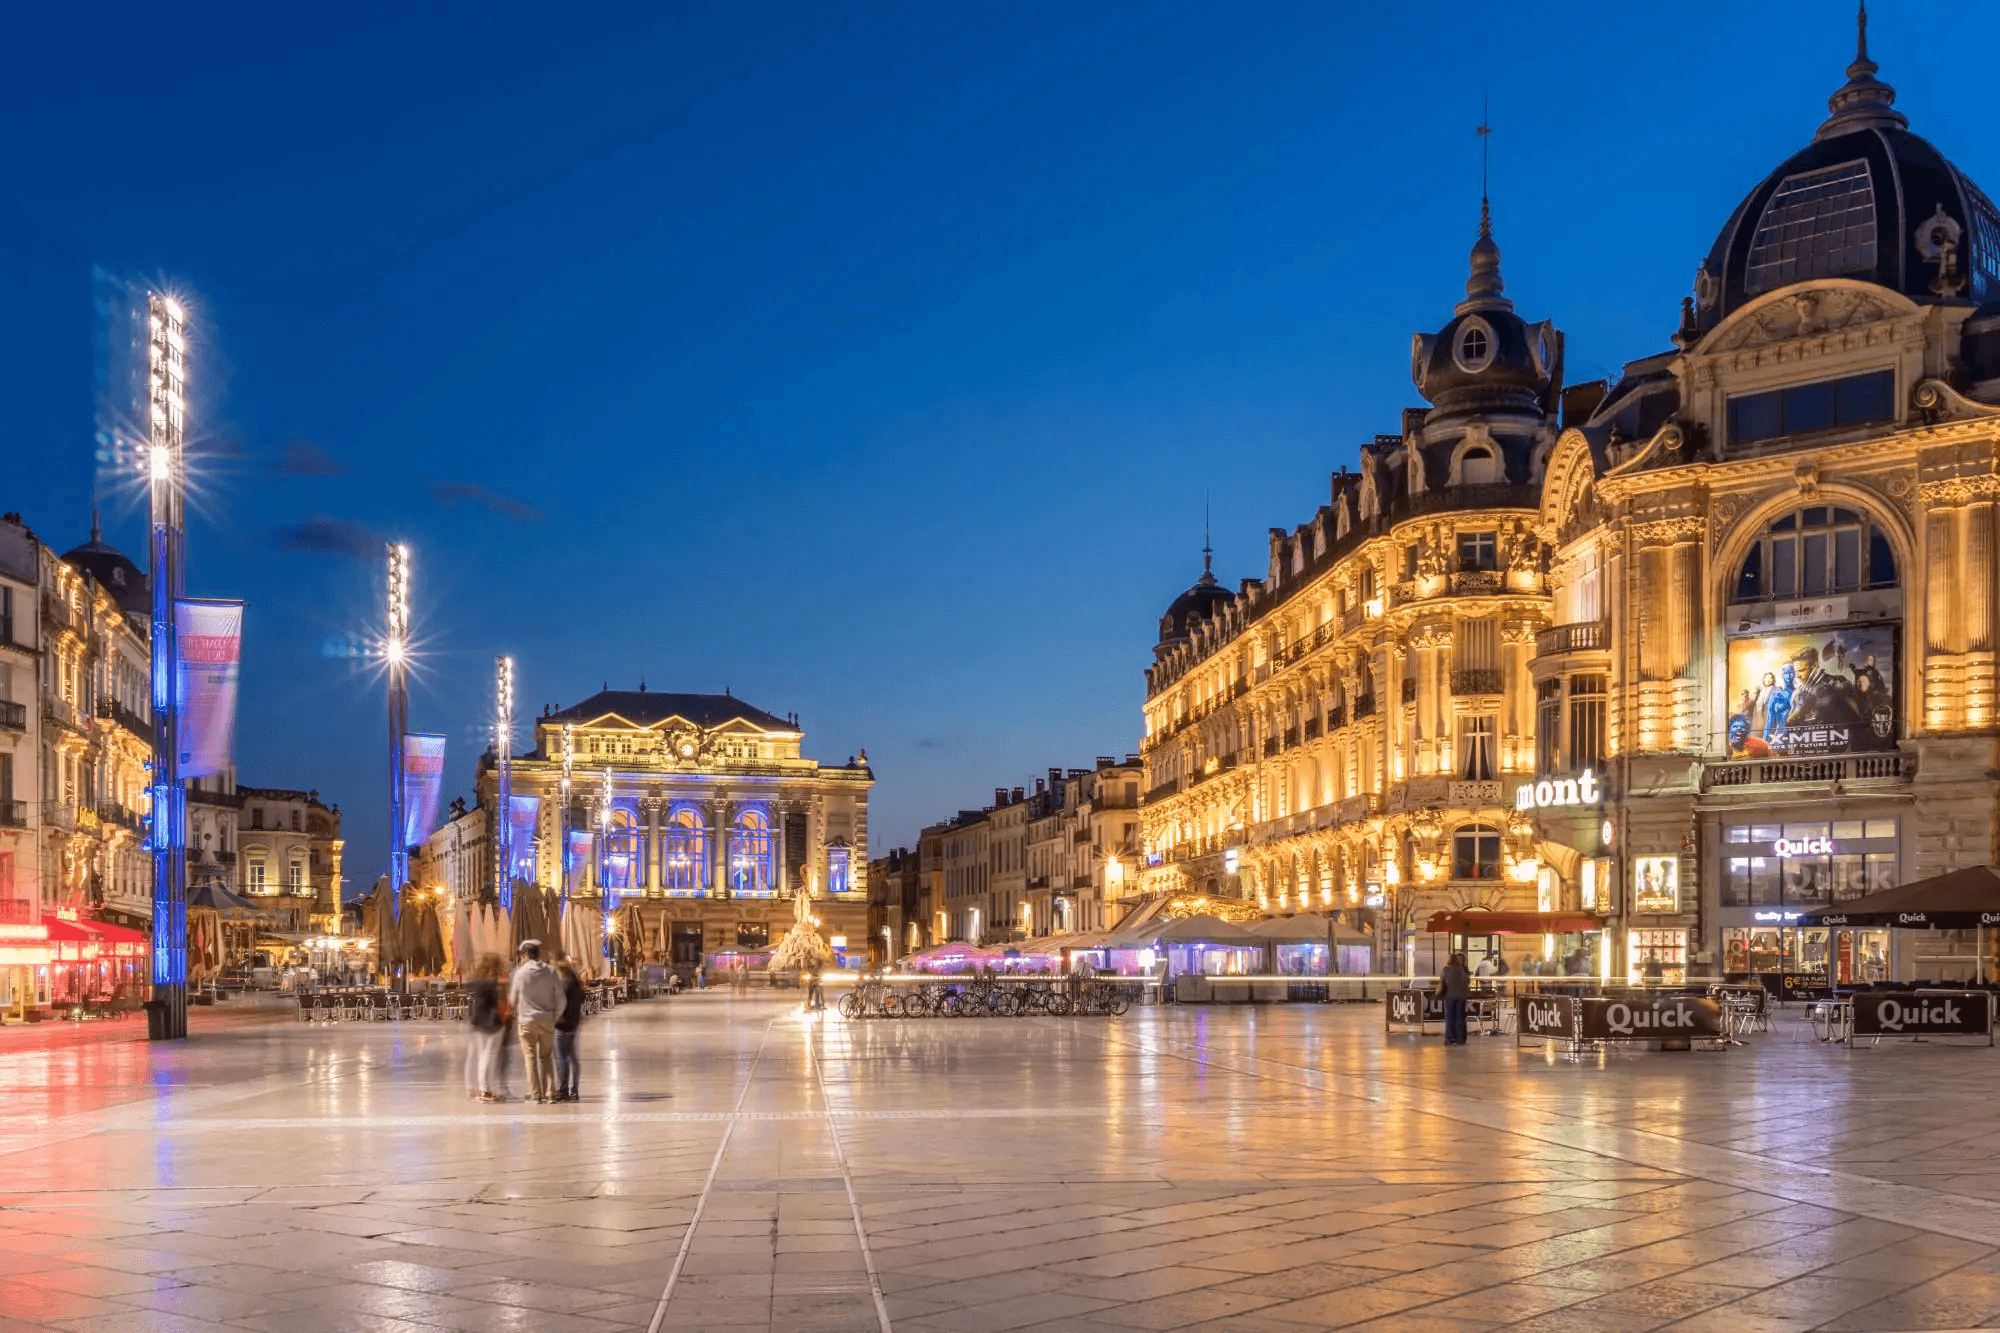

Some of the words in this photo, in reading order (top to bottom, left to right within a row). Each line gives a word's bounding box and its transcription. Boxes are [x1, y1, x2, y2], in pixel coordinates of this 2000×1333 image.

[1768, 729, 1849, 745] X-MEN
[1774, 836, 1833, 858] Quick
[1822, 915, 1848, 925] Quick
[1899, 912, 1926, 923] Quick
[1784, 976, 1801, 989] 6€
[1392, 995, 1415, 1019] Quick
[1527, 1001, 1562, 1031] Quick
[1606, 1002, 1695, 1034] Quick
[1877, 999, 1962, 1030] Quick
